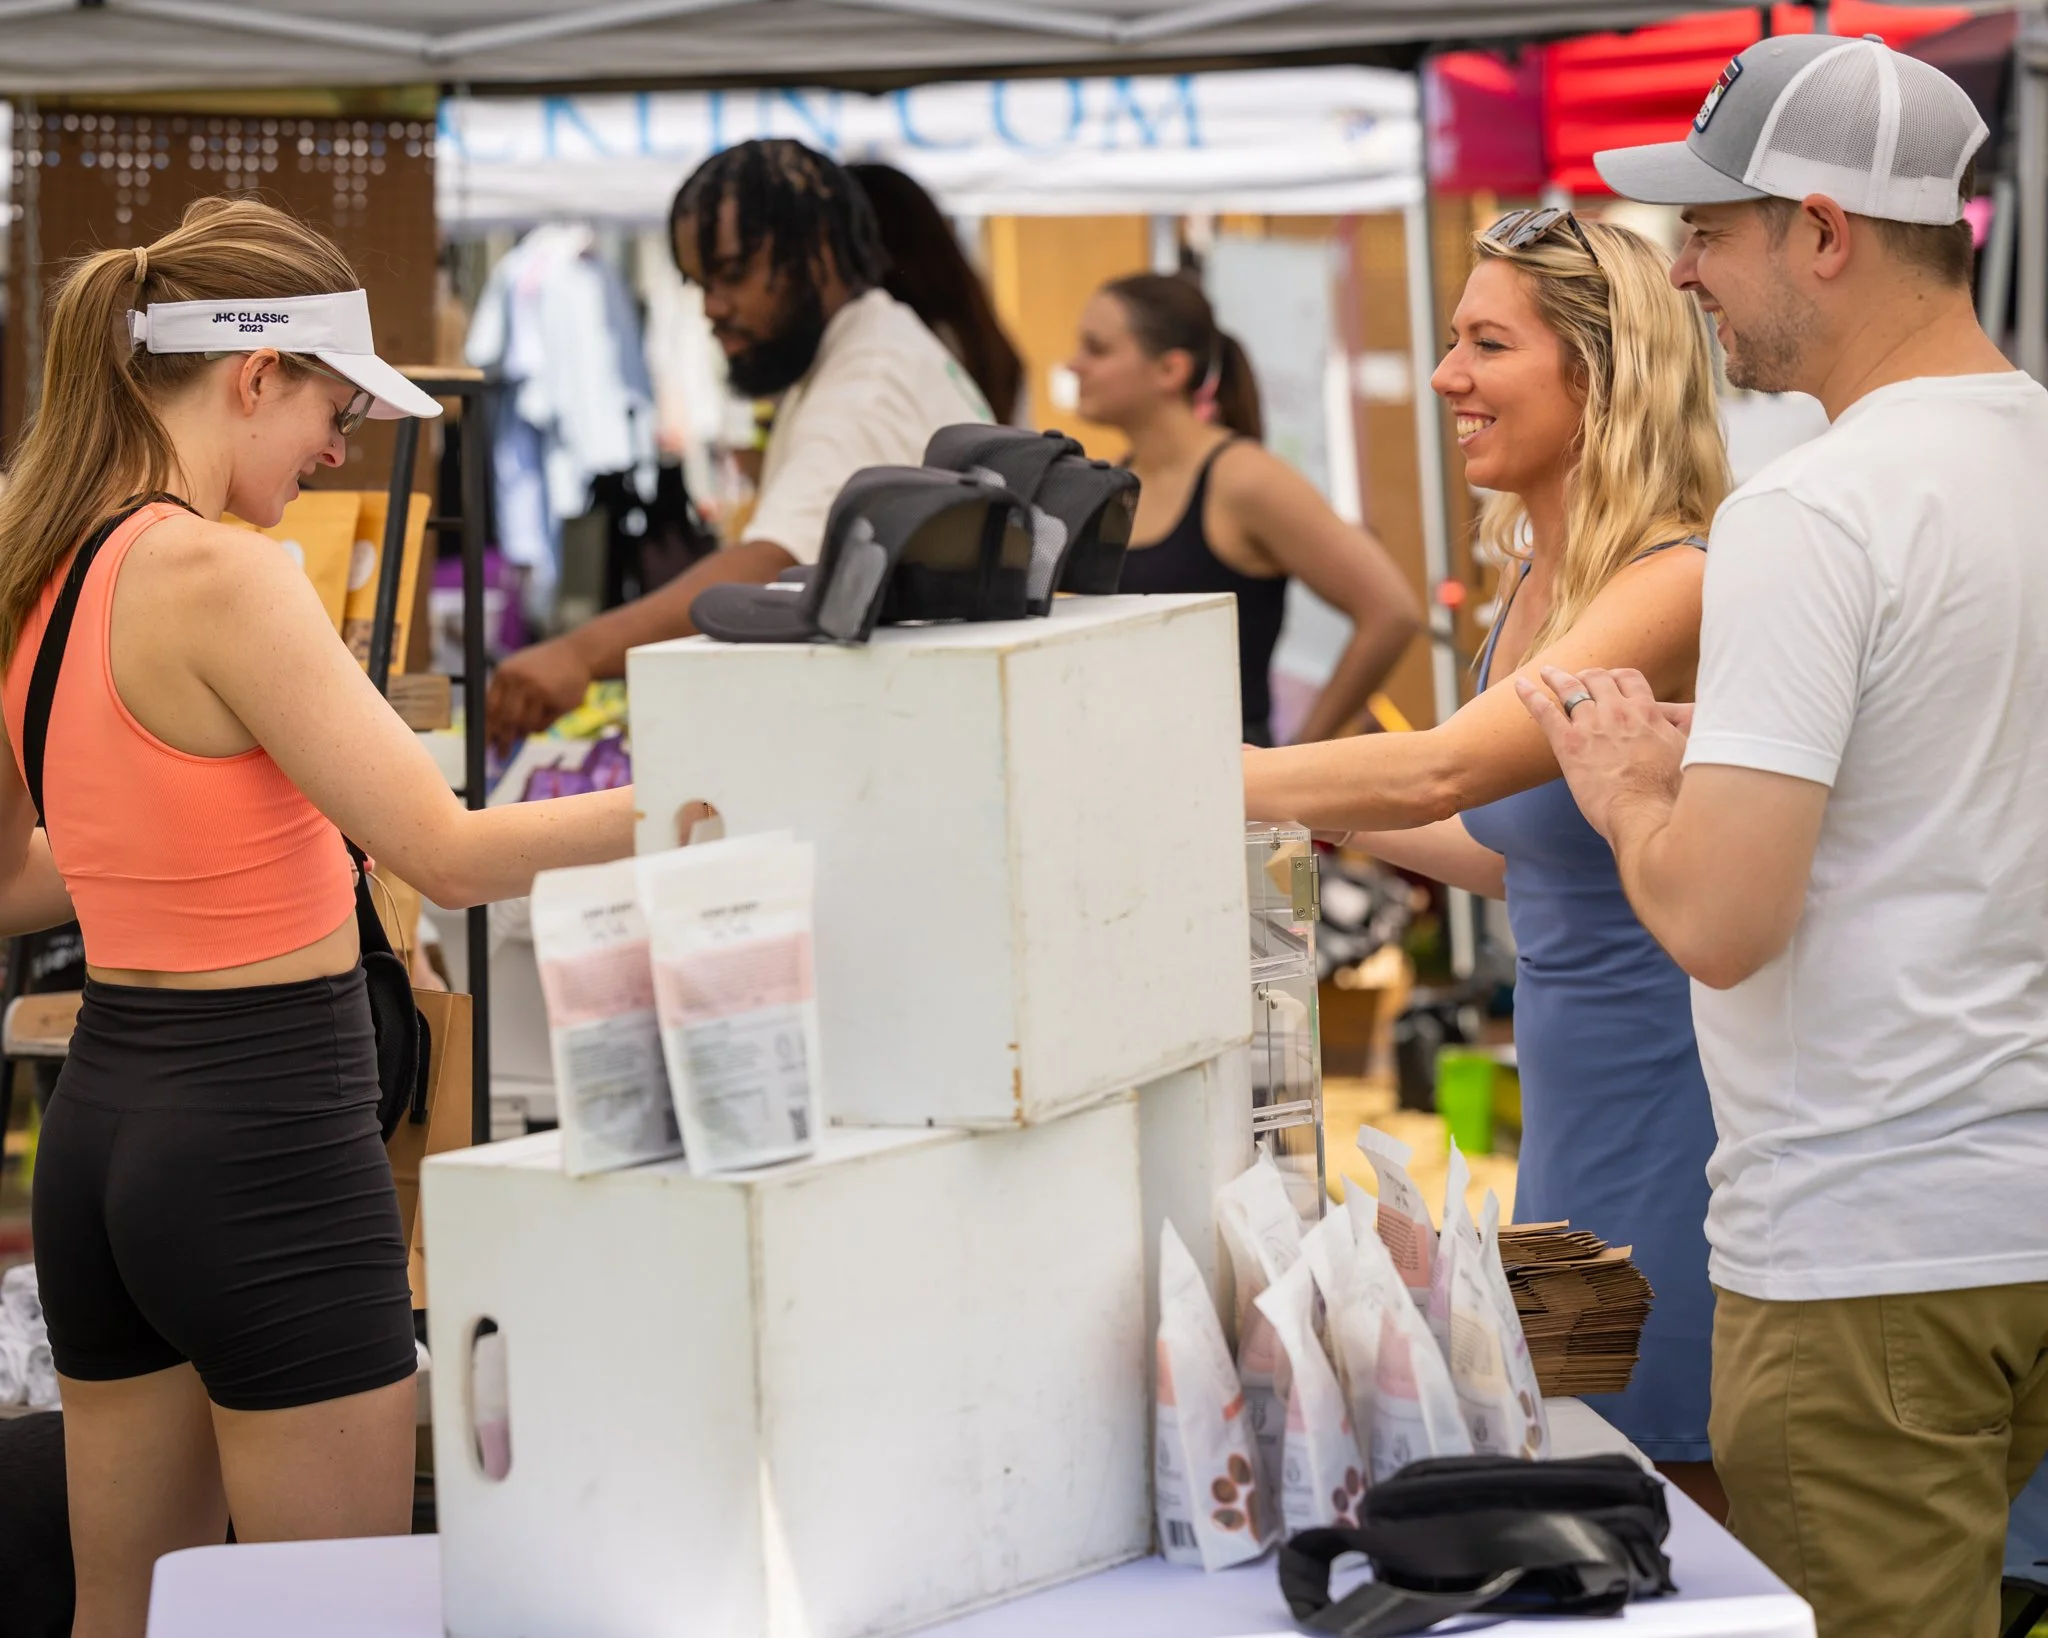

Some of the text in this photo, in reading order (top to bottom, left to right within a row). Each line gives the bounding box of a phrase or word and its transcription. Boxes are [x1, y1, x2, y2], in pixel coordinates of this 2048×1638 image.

[212, 312, 289, 324] JHC CLASSIC
[239, 324, 264, 332] 2023
